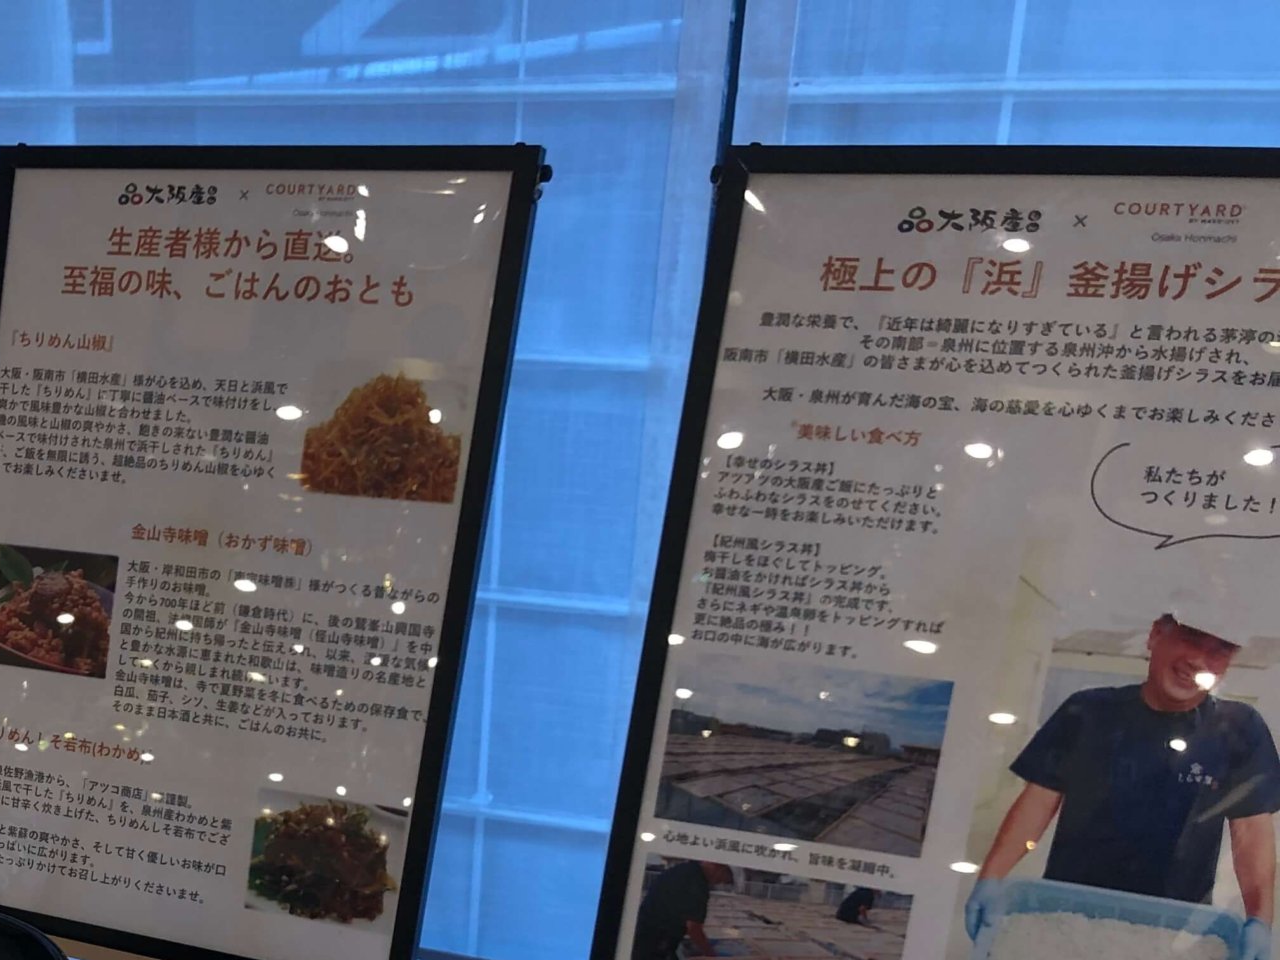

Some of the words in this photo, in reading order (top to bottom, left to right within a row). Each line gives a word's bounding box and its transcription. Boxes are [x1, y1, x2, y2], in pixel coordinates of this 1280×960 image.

[266, 183, 356, 196] COURTYARD
[1114, 202, 1243, 218] COURTYARD
[1152, 232, 1182, 243] Osaka
[61, 264, 413, 307] 至福の味、ごはんのおとも
[818, 256, 1280, 303] 極上の『浜』釜揚げシラ
[758, 312, 1280, 344] 豊潤な栄養で、『近年は綺麗になりすぎている』と言われる茅渟の
[717, 471, 937, 499] アツアツの大阪産ご飯にたっぷりと
[1143, 465, 1226, 487] 私たちが
[713, 487, 941, 517] ふわふわなシラスをのせてください。
[1139, 489, 1276, 514] つくりました！
[711, 503, 938, 533] 幸せな一時をお楽しみいただけます。
[702, 550, 885, 578] 梅干しをほぐしてトッピング。
[125, 575, 210, 596] 手作りのお味噌。
[701, 566, 891, 595] お醤油をかければシラス丼から
[690, 628, 857, 658] お口の中に海が広がります。
[118, 653, 308, 691] してくから親しまれ続います。
[119, 637, 425, 688] と豊かな水源に恵まれた和歌山は、味噌造りの名産地と
[112, 699, 326, 743] そのまま日本酒と共に、ごはんのお共に。
[113, 683, 367, 732] 白瓜、茄子、シソ、生姜などが入っております。
